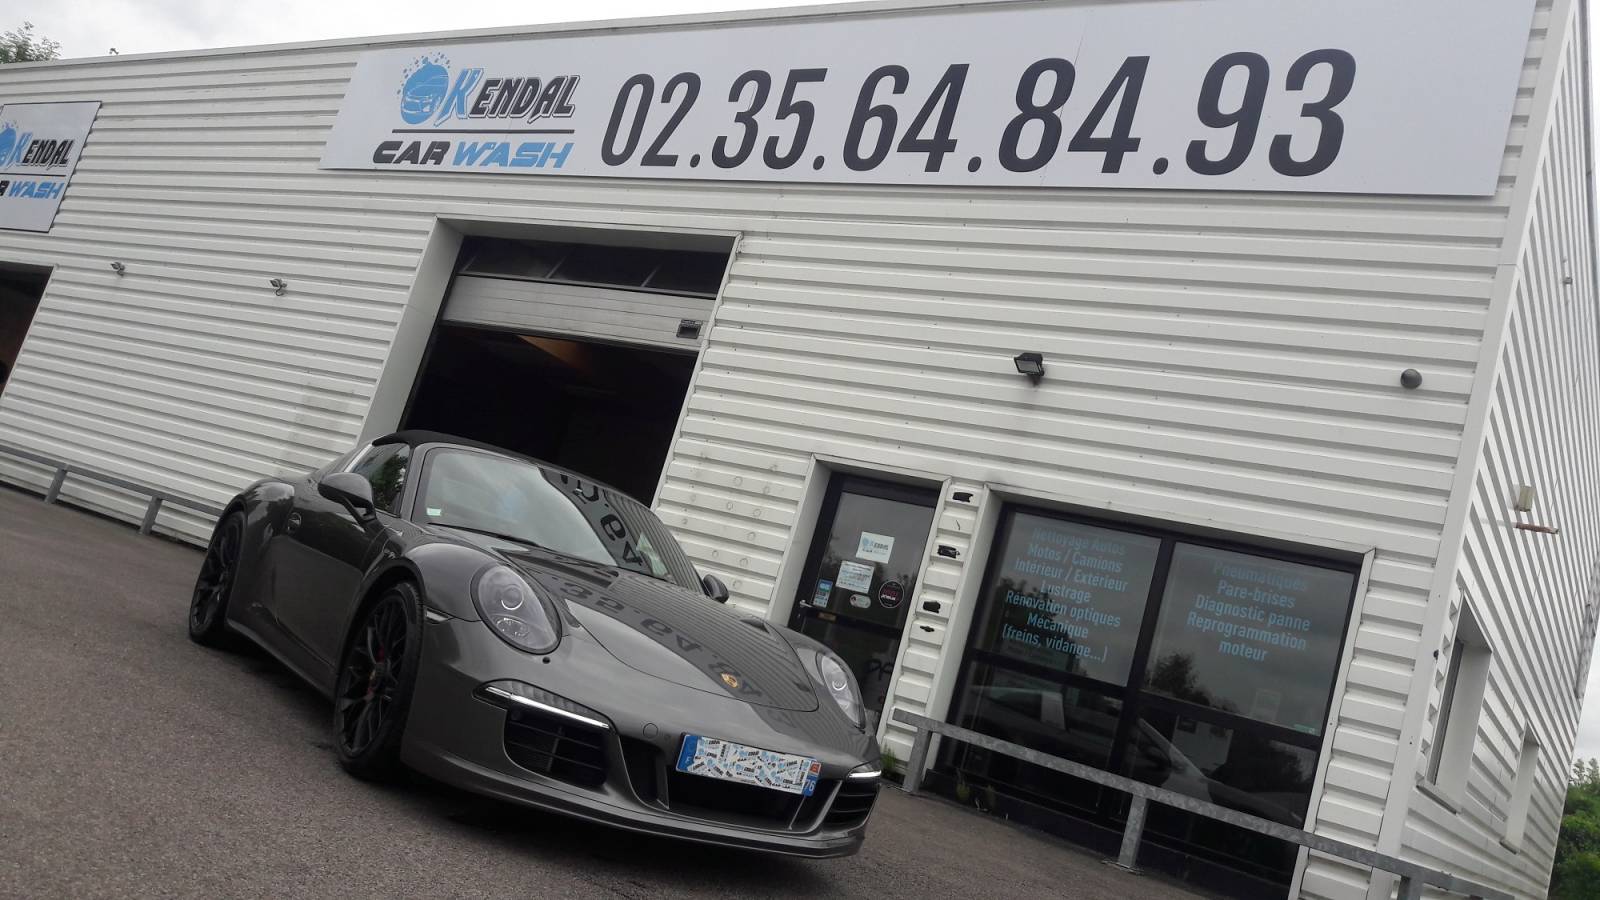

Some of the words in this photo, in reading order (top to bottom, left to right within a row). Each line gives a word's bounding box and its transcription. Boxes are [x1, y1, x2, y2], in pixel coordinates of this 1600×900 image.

[600, 48, 1356, 177] 02.35.64.84.93
[372, 140, 450, 165] CAR
[452, 141, 575, 168] WASH
[9, 180, 65, 199] WASH
[1032, 527, 1088, 550] Nettoyage
[1093, 537, 1126, 555] Autos
[1027, 543, 1061, 561] Motos
[1072, 551, 1123, 572] Camions
[1073, 568, 1128, 592] Extérieur
[1214, 560, 1306, 592] Pneumatiques
[1040, 580, 1092, 602] Lustrage
[1217, 579, 1296, 609] Pare-brises
[1006, 590, 1067, 614] Rénovation
[1070, 605, 1121, 628] optiques
[1194, 594, 1265, 621] Diagnostic
[1267, 611, 1312, 631] panne
[1002, 623, 1041, 649] (freins,
[1027, 612, 1088, 639] Mécanique
[1187, 611, 1306, 651] Reprogrammation
[1218, 640, 1270, 662] moteur
